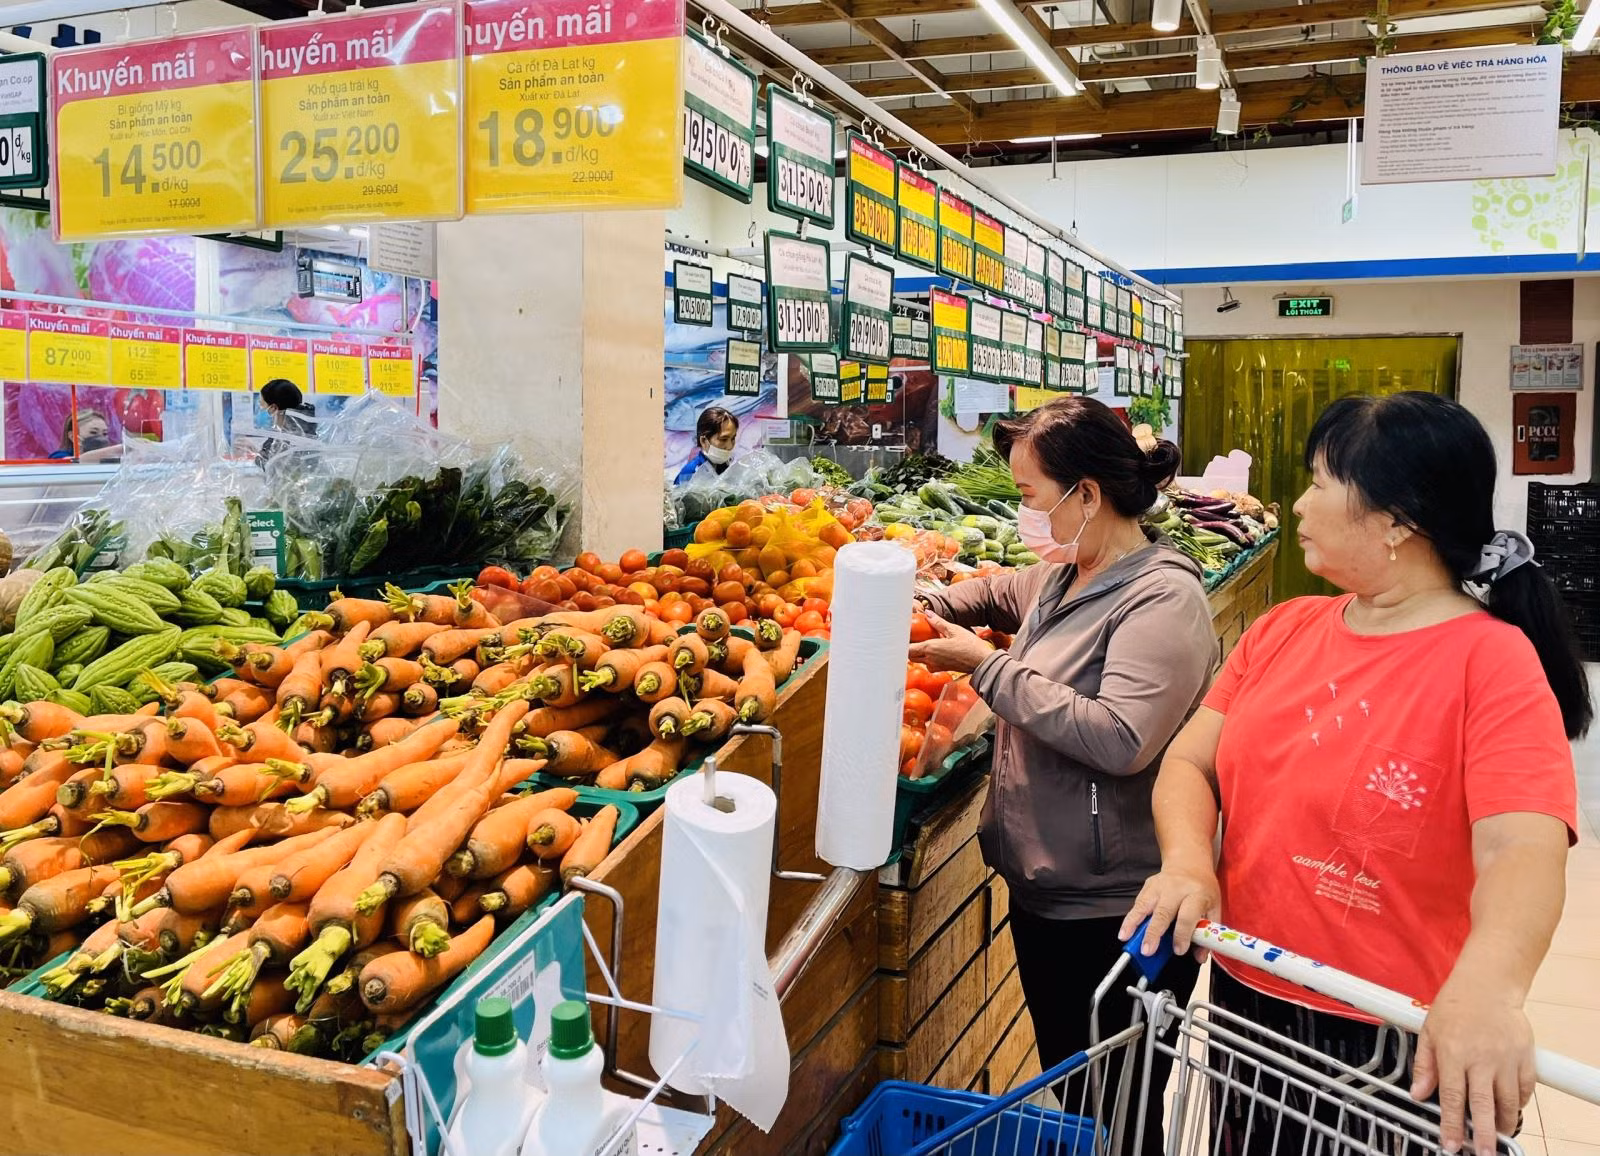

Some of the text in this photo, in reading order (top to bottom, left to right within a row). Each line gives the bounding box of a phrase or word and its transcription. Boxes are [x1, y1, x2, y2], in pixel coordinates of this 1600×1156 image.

[464, 4, 612, 50] huyến mãi
[261, 29, 394, 74] huyến mãi
[57, 51, 196, 95] Khuyến mãi
[524, 58, 540, 72] rốt
[543, 58, 559, 70] Đà
[562, 58, 580, 72] Lạt
[582, 57, 596, 70] kg
[1381, 64, 1414, 74] THÔNG
[330, 83, 347, 94] qua
[368, 78, 379, 90] kg
[500, 72, 604, 91] Sản phẩm an toàn
[172, 99, 182, 112] kg
[299, 92, 390, 113] Sản phẩm an toàn
[109, 112, 192, 132] Sản phẩm an toàn
[566, 145, 599, 164] đ/kg
[356, 161, 385, 178] đ/kg
[162, 176, 188, 193] đ/kg
[781, 164, 823, 205] 31.500
[1290, 300, 1320, 308] EXIT
[30, 318, 90, 334] Khuyến mãi
[778, 304, 820, 334] 31.500
[110, 326, 163, 340] Khuyến mãi
[186, 333, 232, 346] Khuyến mãi
[852, 319, 884, 348] 29.900
[251, 338, 292, 350] Khuyến mãi
[1529, 426, 1560, 437] PCCC
